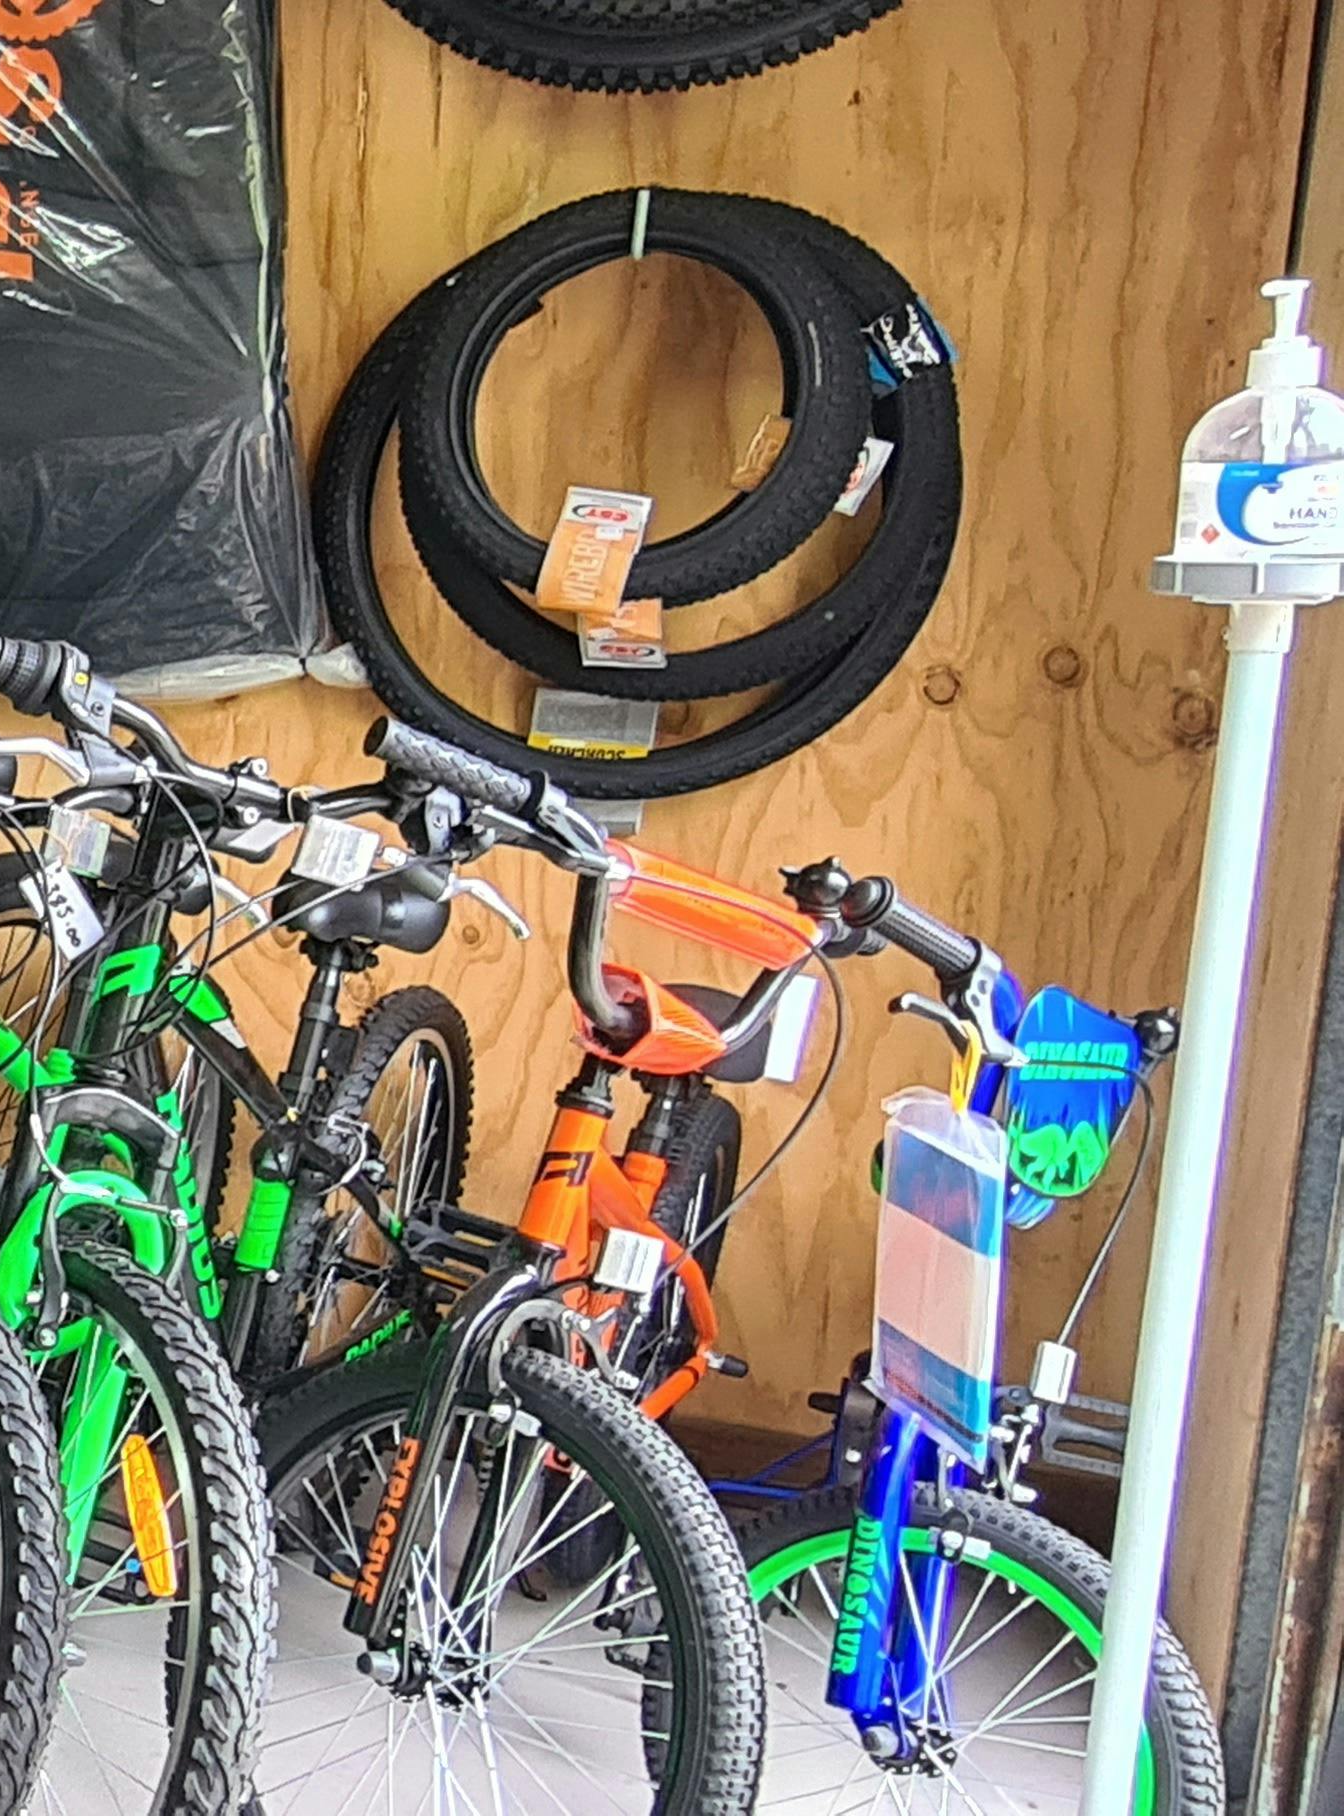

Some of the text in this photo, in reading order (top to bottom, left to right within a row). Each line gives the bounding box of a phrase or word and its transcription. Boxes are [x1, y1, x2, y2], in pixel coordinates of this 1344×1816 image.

[1019, 1040, 1130, 1082] DINOSAUR
[355, 1435, 421, 1606] EXPLOSIVE
[831, 1516, 884, 1675] DINOSAUR
